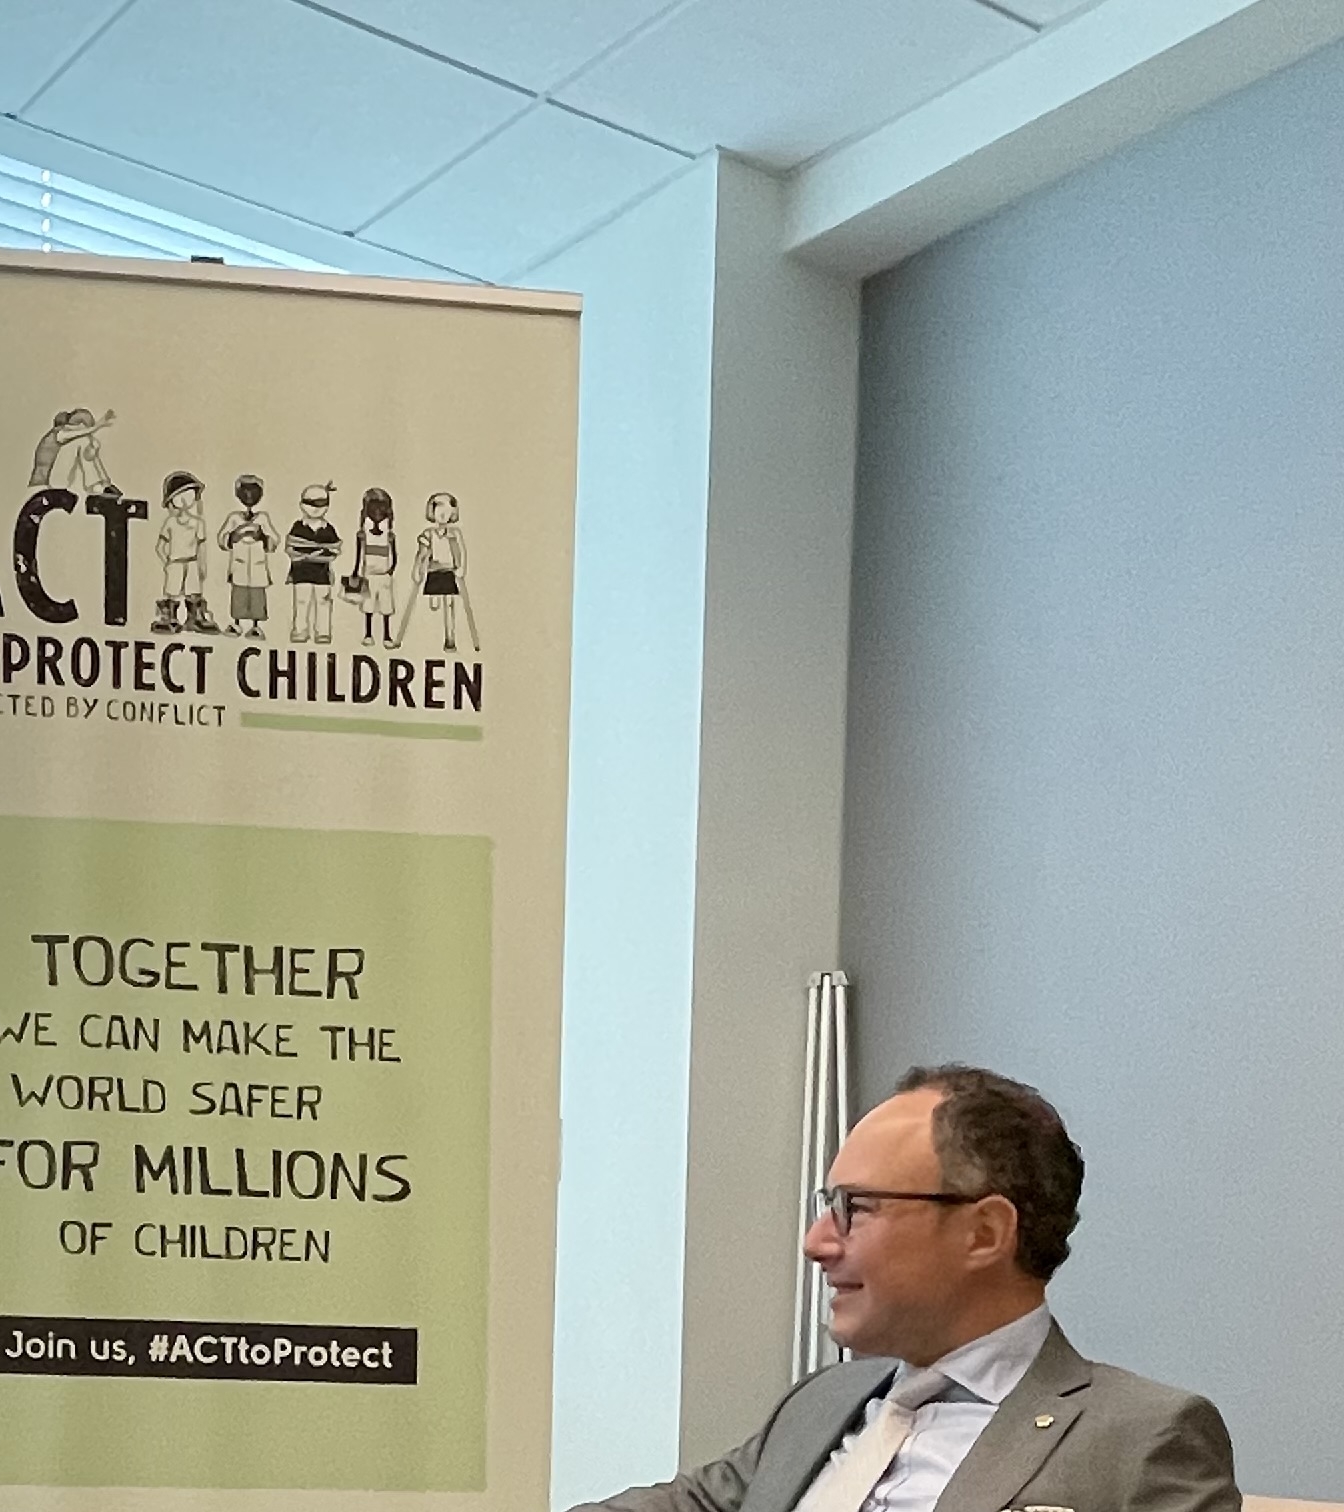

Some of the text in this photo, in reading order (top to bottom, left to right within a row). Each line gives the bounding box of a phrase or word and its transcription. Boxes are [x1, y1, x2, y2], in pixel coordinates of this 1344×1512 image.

[2, 632, 214, 694] PROTECT
[236, 646, 483, 711] CHILDREN
[66, 697, 98, 719] BY
[105, 699, 227, 728] CONFLICT
[31, 934, 366, 1000] TOGETHER
[79, 1013, 160, 1052] CAN
[182, 1019, 299, 1058] MAKE
[320, 1025, 402, 1063] THE
[10, 1072, 323, 1121] WORLD SAFER
[134, 1144, 413, 1203] MILLIONS
[59, 1220, 331, 1264] OF CHILDREN
[4, 1330, 394, 1370] Join us, #ACTtoProtect
